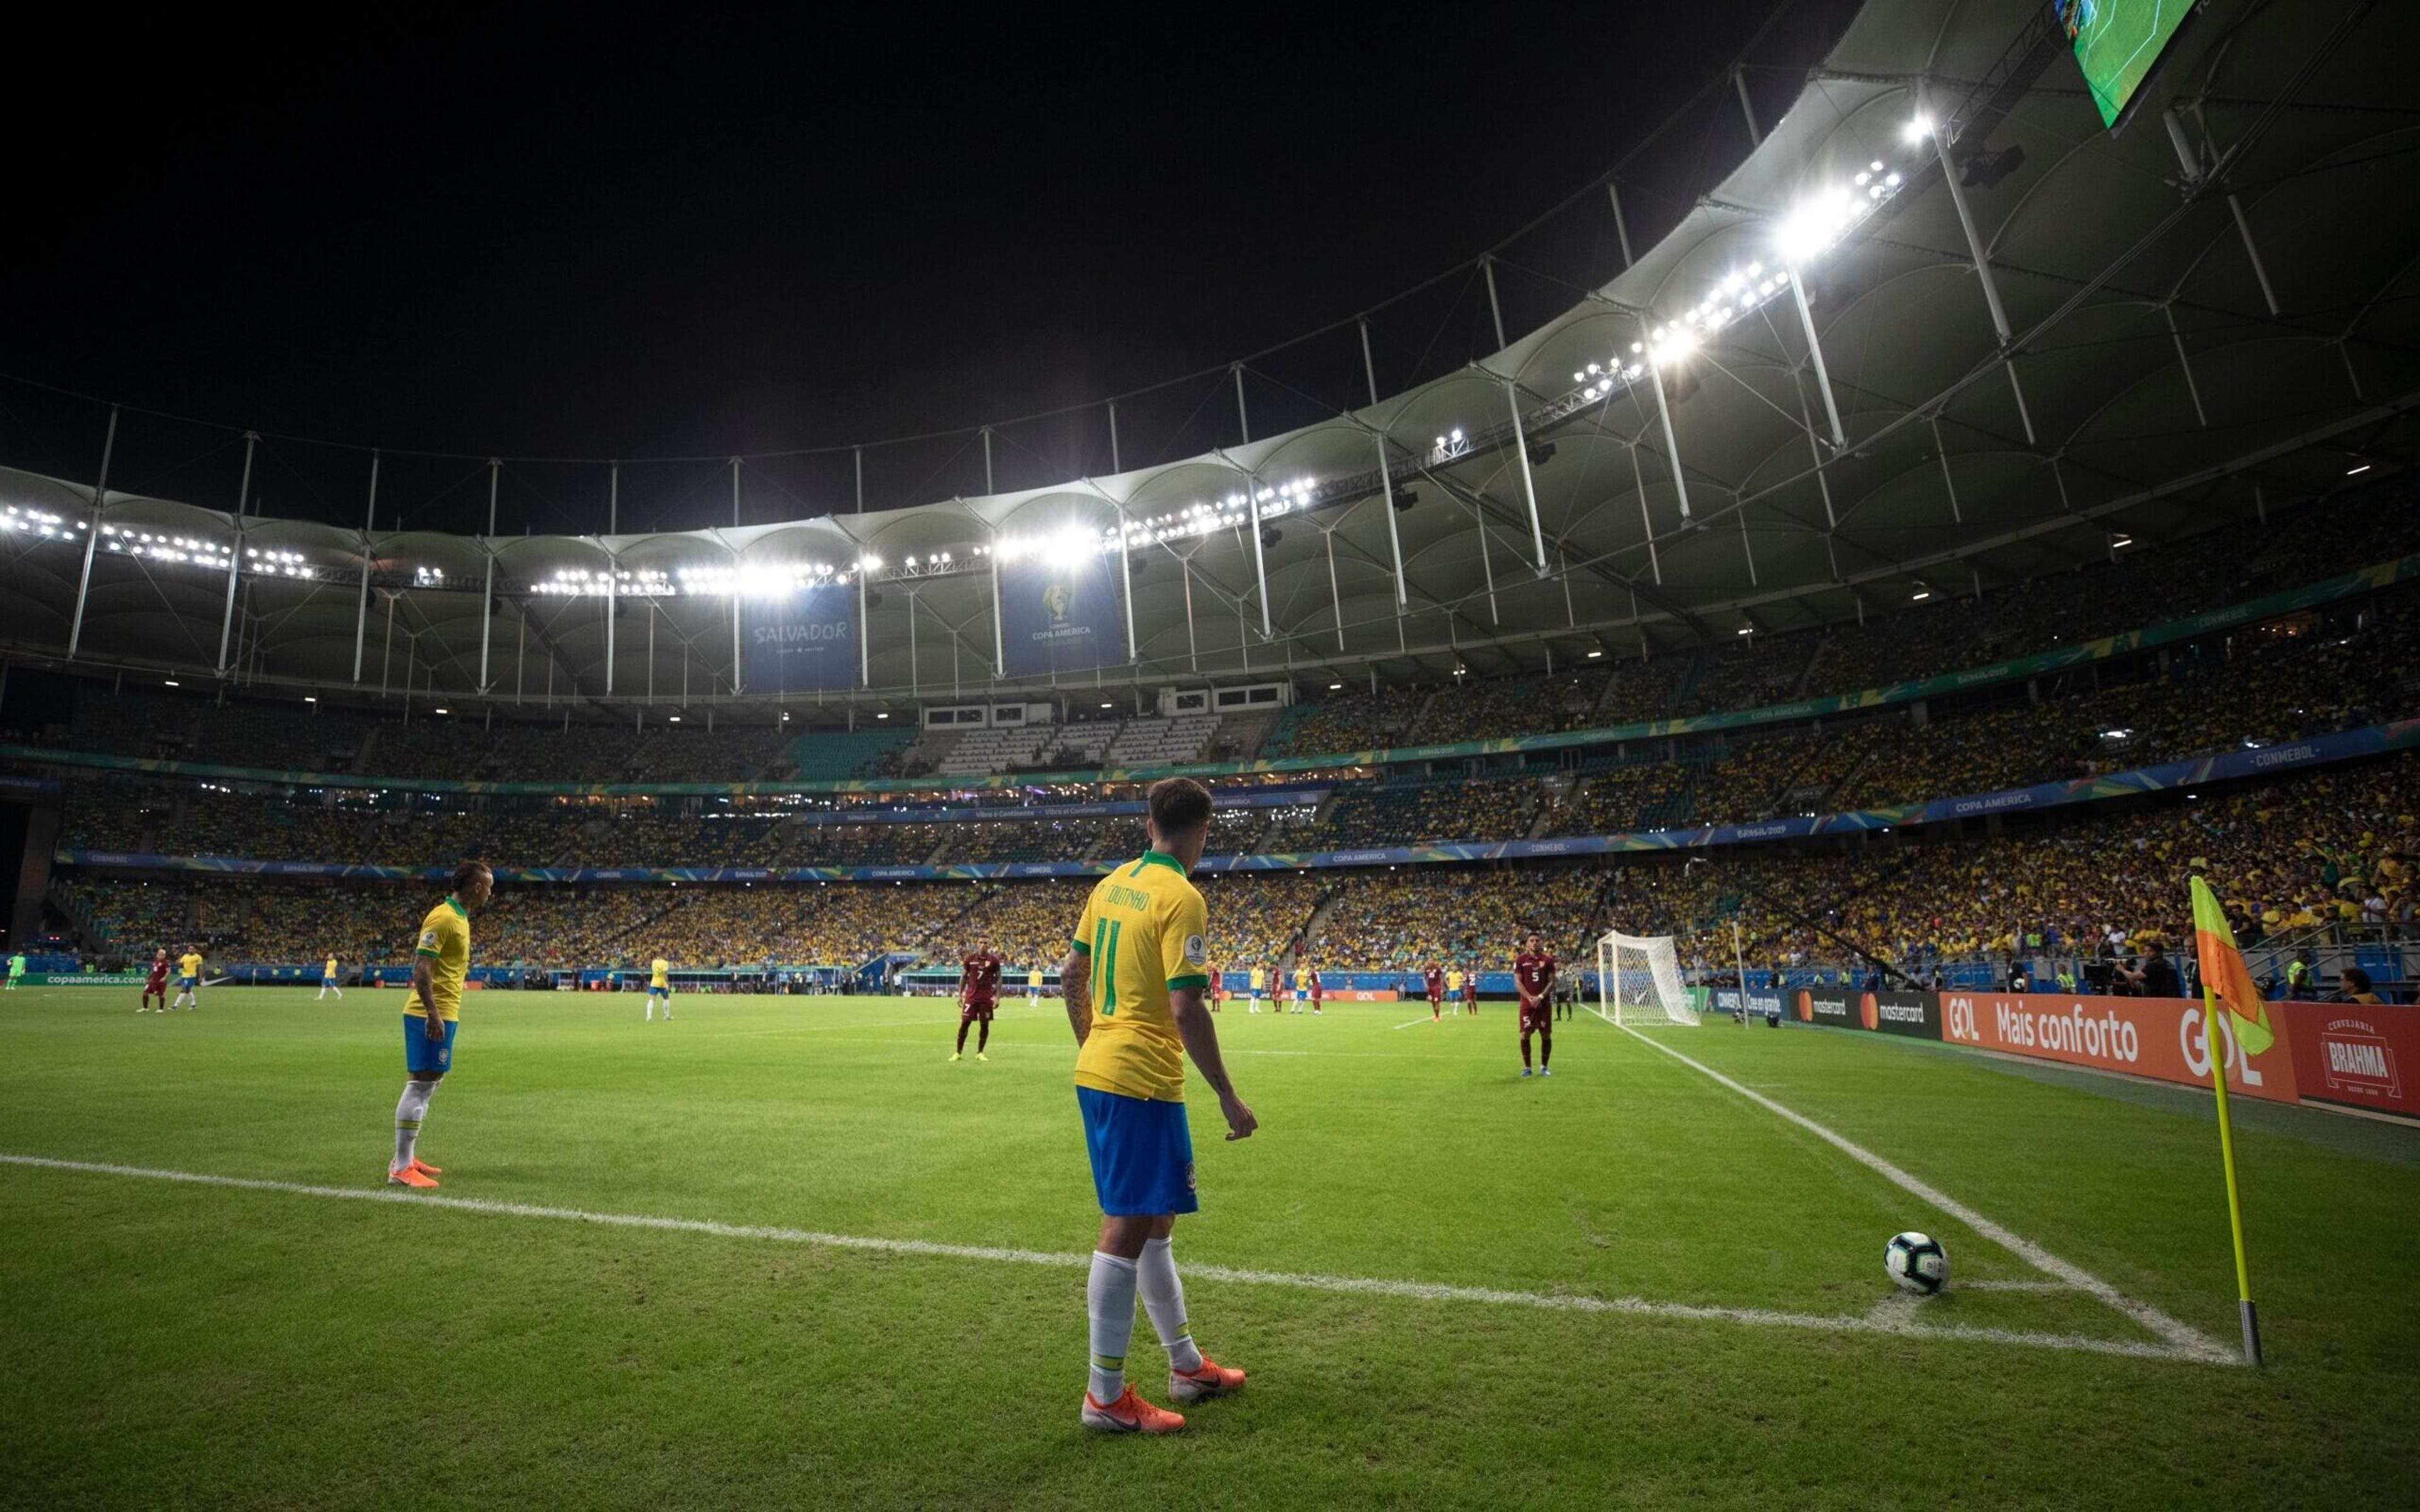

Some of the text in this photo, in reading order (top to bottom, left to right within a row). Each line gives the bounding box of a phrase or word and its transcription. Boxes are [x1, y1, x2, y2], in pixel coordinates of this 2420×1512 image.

[755, 622, 847, 644] SALVADOR
[1032, 626, 1091, 640] COPA AMERICA
[2256, 745, 2315, 767] CONMEBOL
[1955, 793, 2032, 813] COPA AMERICA
[1531, 842, 1567, 853] CONMEBOL
[1333, 852, 1386, 862] COPA AMERICA
[1092, 917, 1122, 1016] 11
[47, 975, 146, 985] copaamerica.com
[977, 971, 984, 980] 7
[1531, 971, 1540, 982] 5
[1356, 992, 1375, 1000] GOL
[964, 1004, 971, 1012] 7
[1813, 999, 1846, 1016] mastercard
[1879, 1002, 1924, 1023] mastercard
[1523, 1016, 1531, 1028] 5
[1949, 997, 1979, 1041] GOL
[2328, 1019, 2375, 1034] CERVEJARIA
[1996, 1000, 2138, 1063] Mais conforto
[2180, 1008, 2262, 1086] GOL
[2328, 1041, 2388, 1078] BRAHMA
